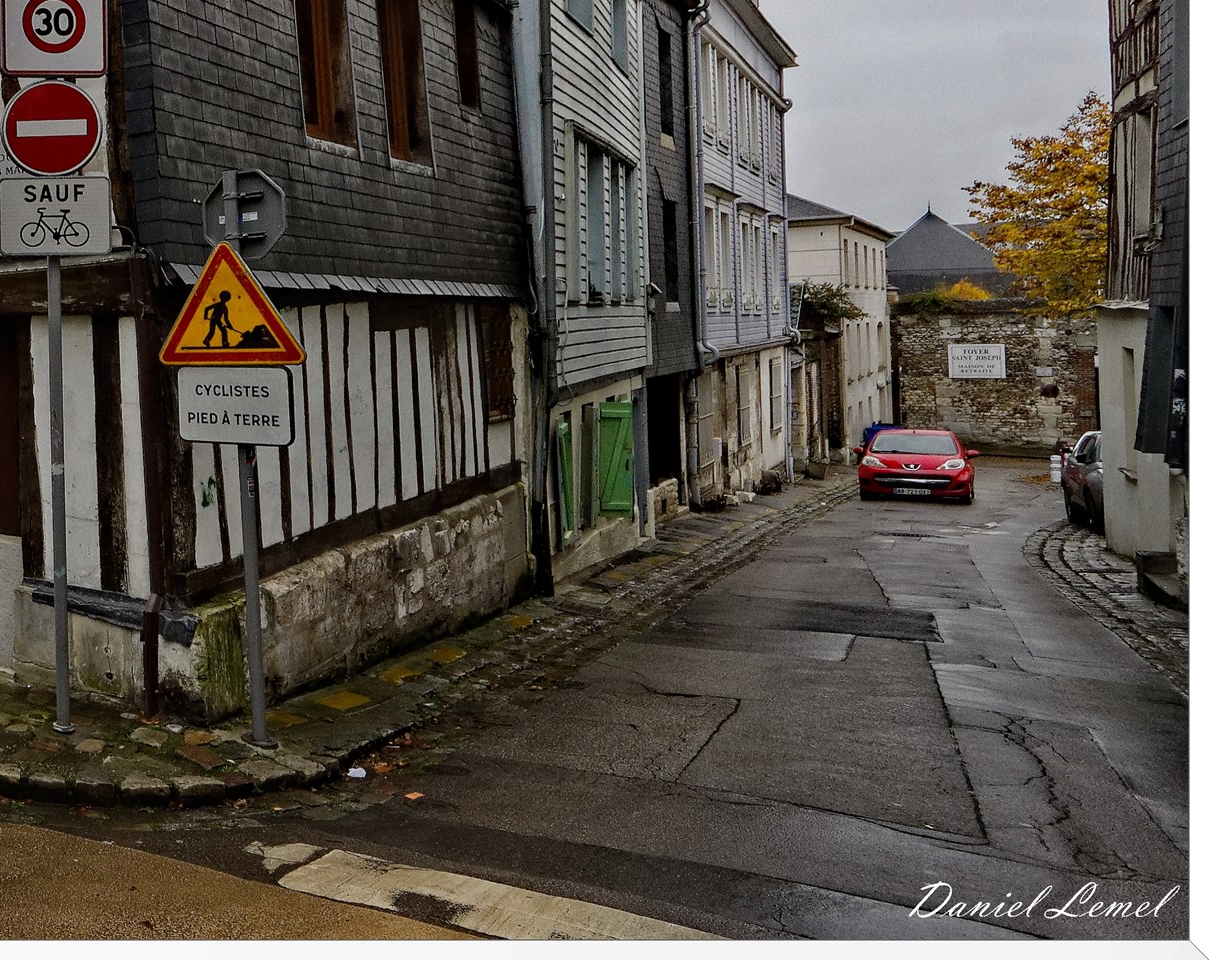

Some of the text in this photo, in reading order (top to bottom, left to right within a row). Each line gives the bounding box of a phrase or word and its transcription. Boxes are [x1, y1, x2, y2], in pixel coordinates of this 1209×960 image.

[34, 7, 75, 36] 30
[23, 184, 85, 203] SAUF
[195, 384, 270, 398] CYCLISTES
[187, 410, 280, 428] PIED À TERRE
